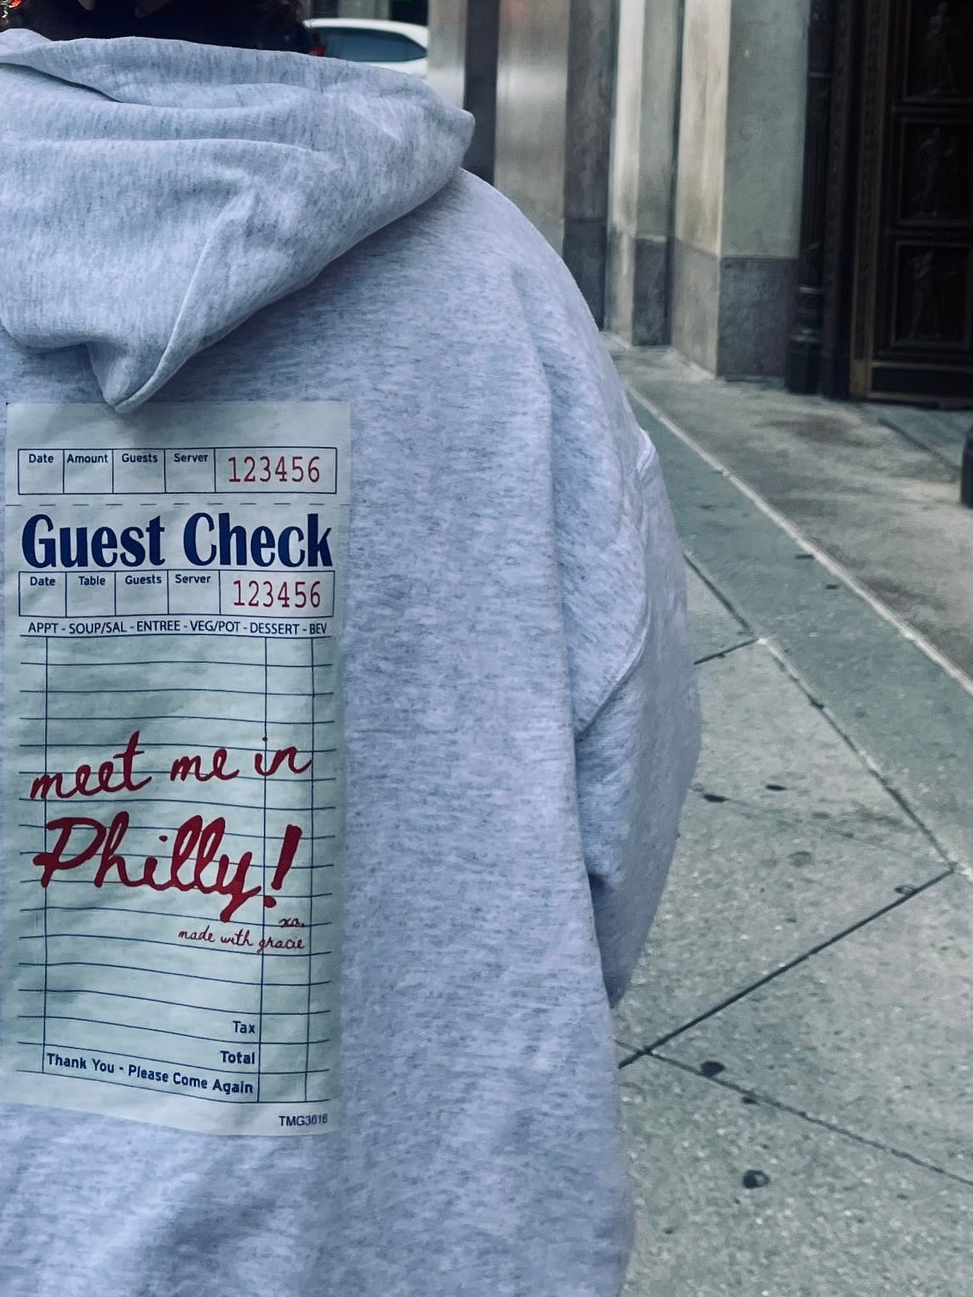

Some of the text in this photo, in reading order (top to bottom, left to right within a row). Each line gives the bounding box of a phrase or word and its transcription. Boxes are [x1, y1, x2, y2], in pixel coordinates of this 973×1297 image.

[28, 453, 54, 464] Date
[66, 453, 108, 465] Amount
[121, 453, 158, 463] Guests
[173, 453, 208, 463] Server
[228, 456, 320, 483] 123456
[21, 512, 333, 568] Guest Check
[29, 576, 56, 587] Date
[78, 576, 106, 586] Table
[125, 574, 162, 585] Guests
[175, 574, 211, 584] Server
[233, 580, 322, 608] 123456
[28, 622, 58, 634] APPT
[69, 622, 127, 634] SOUP/SAL
[137, 620, 180, 632] ENTREE
[190, 620, 240, 633] VEG/POT
[250, 623, 299, 635] DESSERT
[310, 622, 327, 634] BEV
[30, 730, 312, 799] meet me in
[33, 811, 303, 923] Philly!
[178, 925, 305, 955] made with gracie
[233, 1021, 255, 1034] Tax
[221, 1051, 255, 1065] Total
[47, 1053, 87, 1070] Thank
[92, 1058, 115, 1074] You
[128, 1064, 169, 1083] Please
[173, 1072, 208, 1089] Come
[212, 1079, 253, 1095] Again
